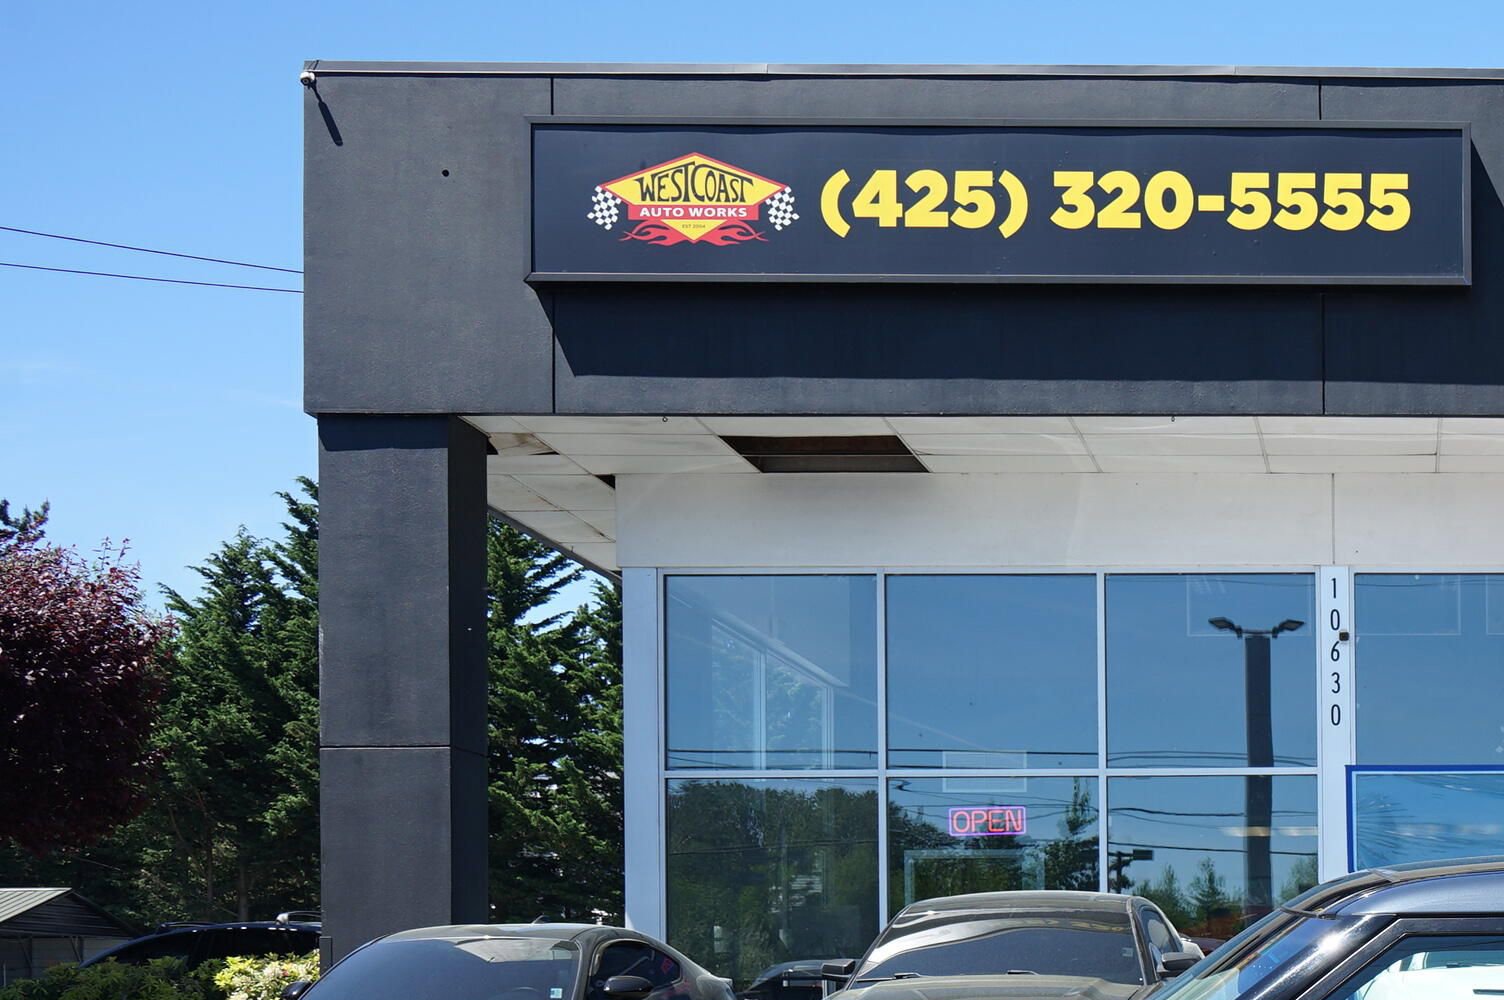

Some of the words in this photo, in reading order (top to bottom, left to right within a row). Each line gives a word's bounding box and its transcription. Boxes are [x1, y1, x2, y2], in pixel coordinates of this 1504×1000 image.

[639, 207, 684, 217] AUTO
[689, 207, 747, 217] WORKS
[821, 169, 1028, 238] (425)
[1050, 170, 1411, 231] 320-5555
[952, 809, 1022, 832] OPEN
